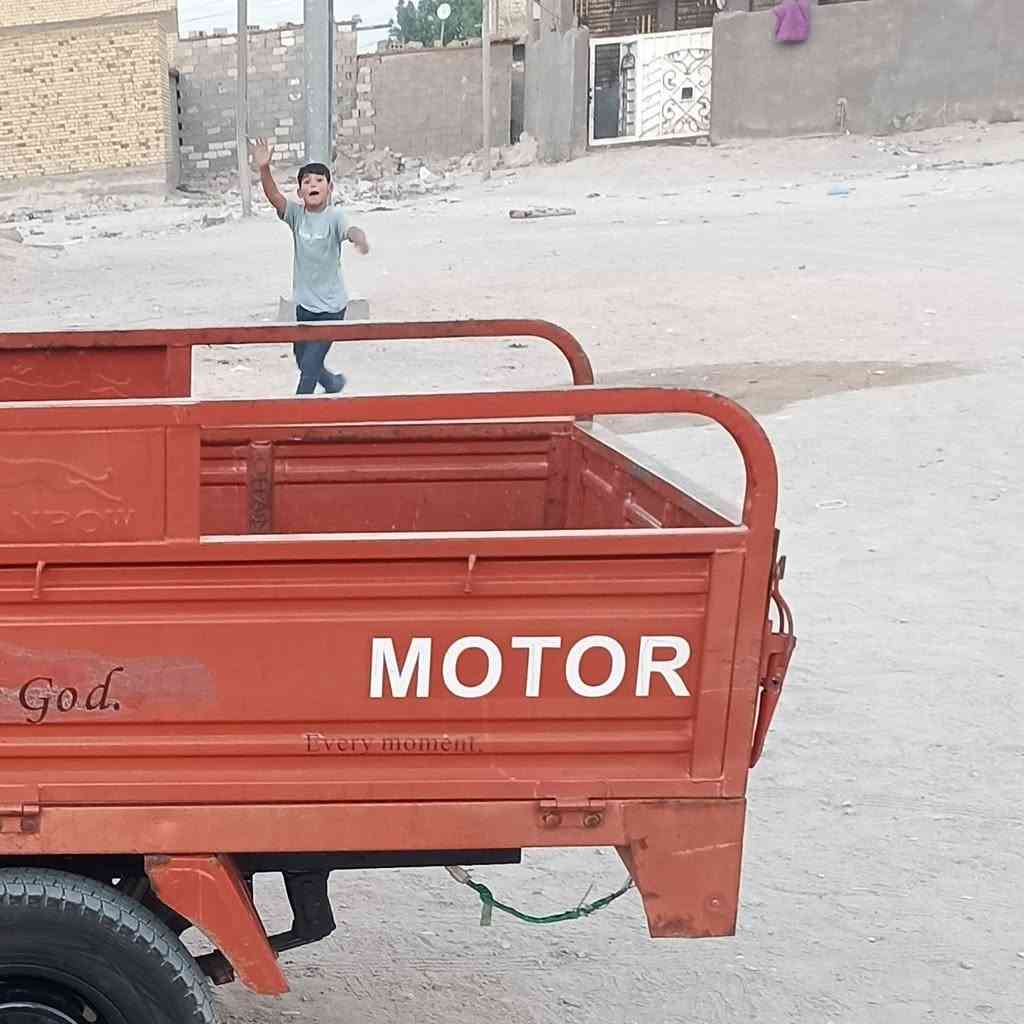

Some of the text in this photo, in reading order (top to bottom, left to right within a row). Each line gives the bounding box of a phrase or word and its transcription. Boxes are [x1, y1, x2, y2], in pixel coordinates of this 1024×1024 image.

[18, 666, 125, 726] God.
[369, 635, 692, 699] MOTOR
[304, 733, 370, 755] Every
